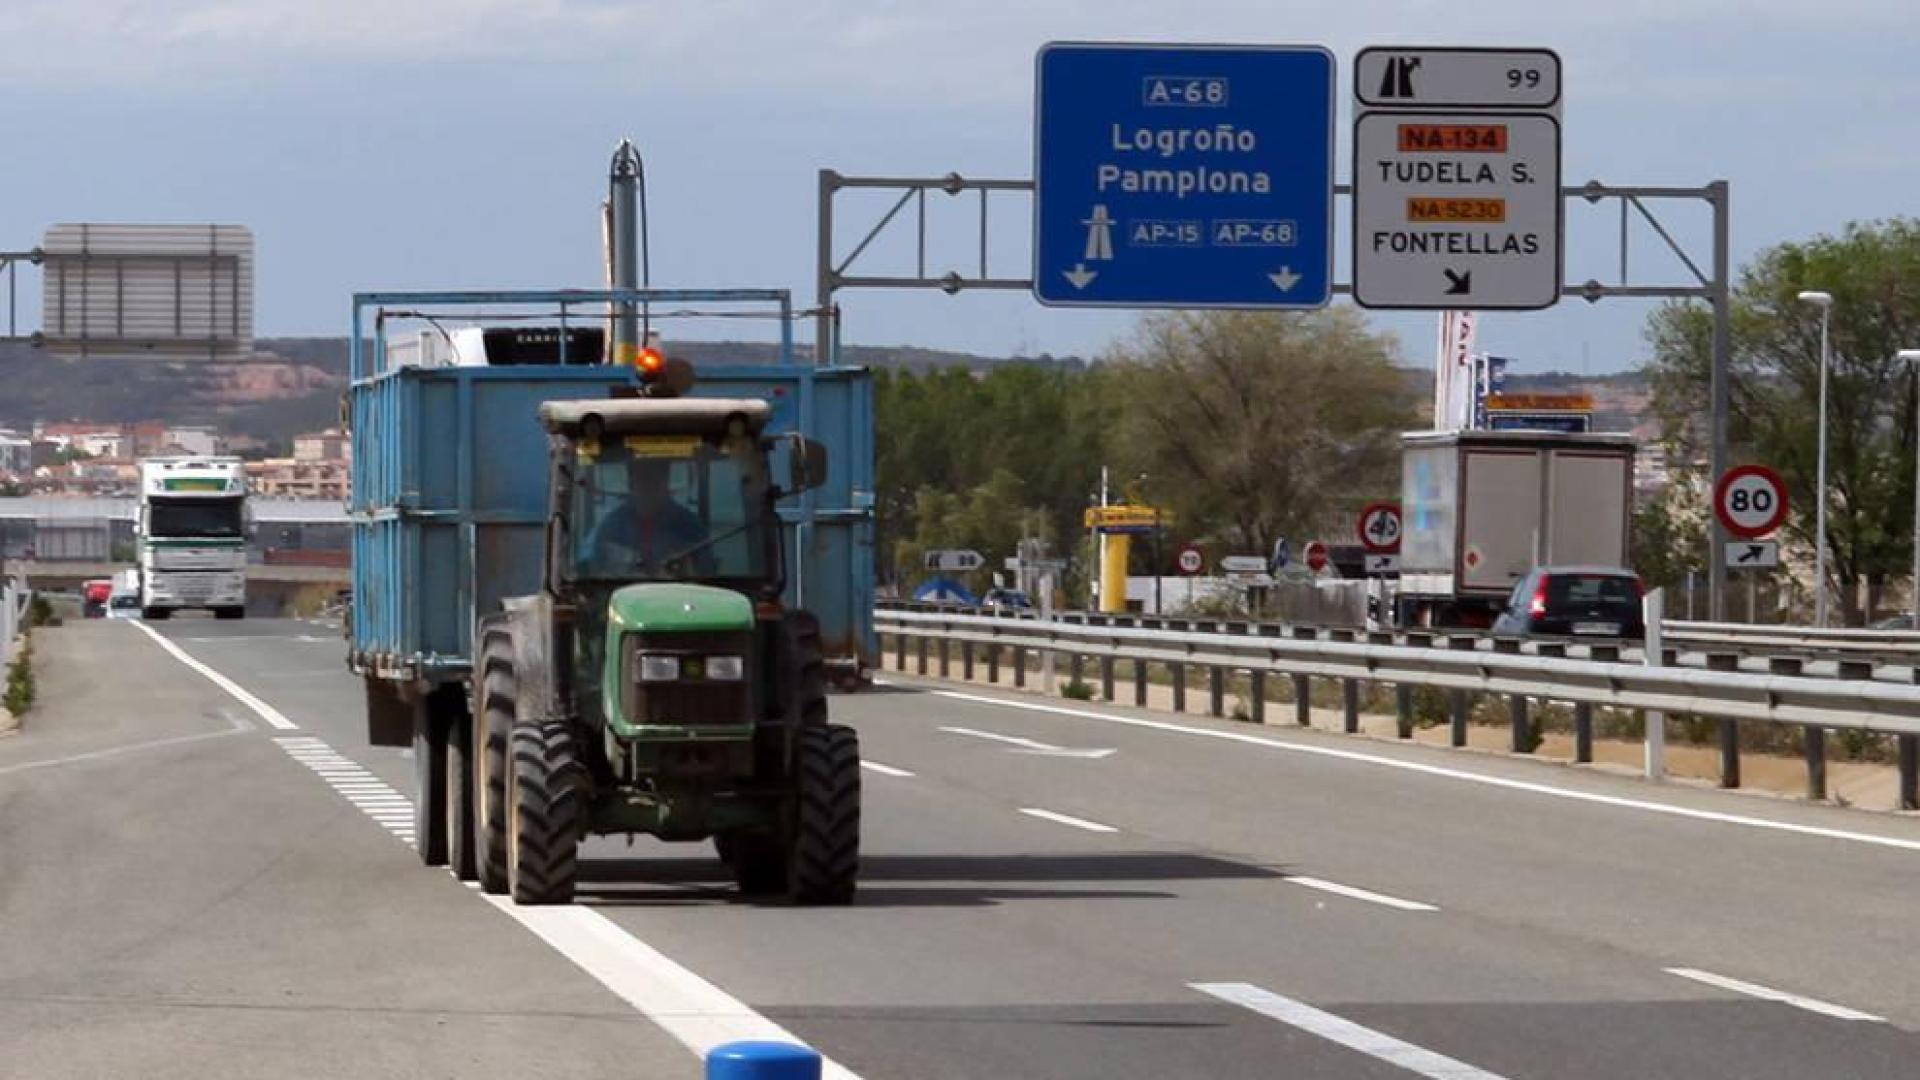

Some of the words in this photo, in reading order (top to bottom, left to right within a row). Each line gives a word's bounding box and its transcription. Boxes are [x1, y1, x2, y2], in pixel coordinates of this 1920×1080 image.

[1506, 69, 1541, 88] 99
[1150, 80, 1225, 102] A-68
[1112, 123, 1256, 157] Logroño
[1405, 128, 1498, 148] NA-134
[1098, 165, 1271, 198] Pamplona
[1378, 161, 1495, 183] TUDELA
[1510, 162, 1535, 183] S.
[1133, 224, 1199, 242] AP-15
[1216, 224, 1292, 242] AP-68
[1373, 232, 1539, 254] FONTELLAS
[1732, 488, 1772, 512] 80
